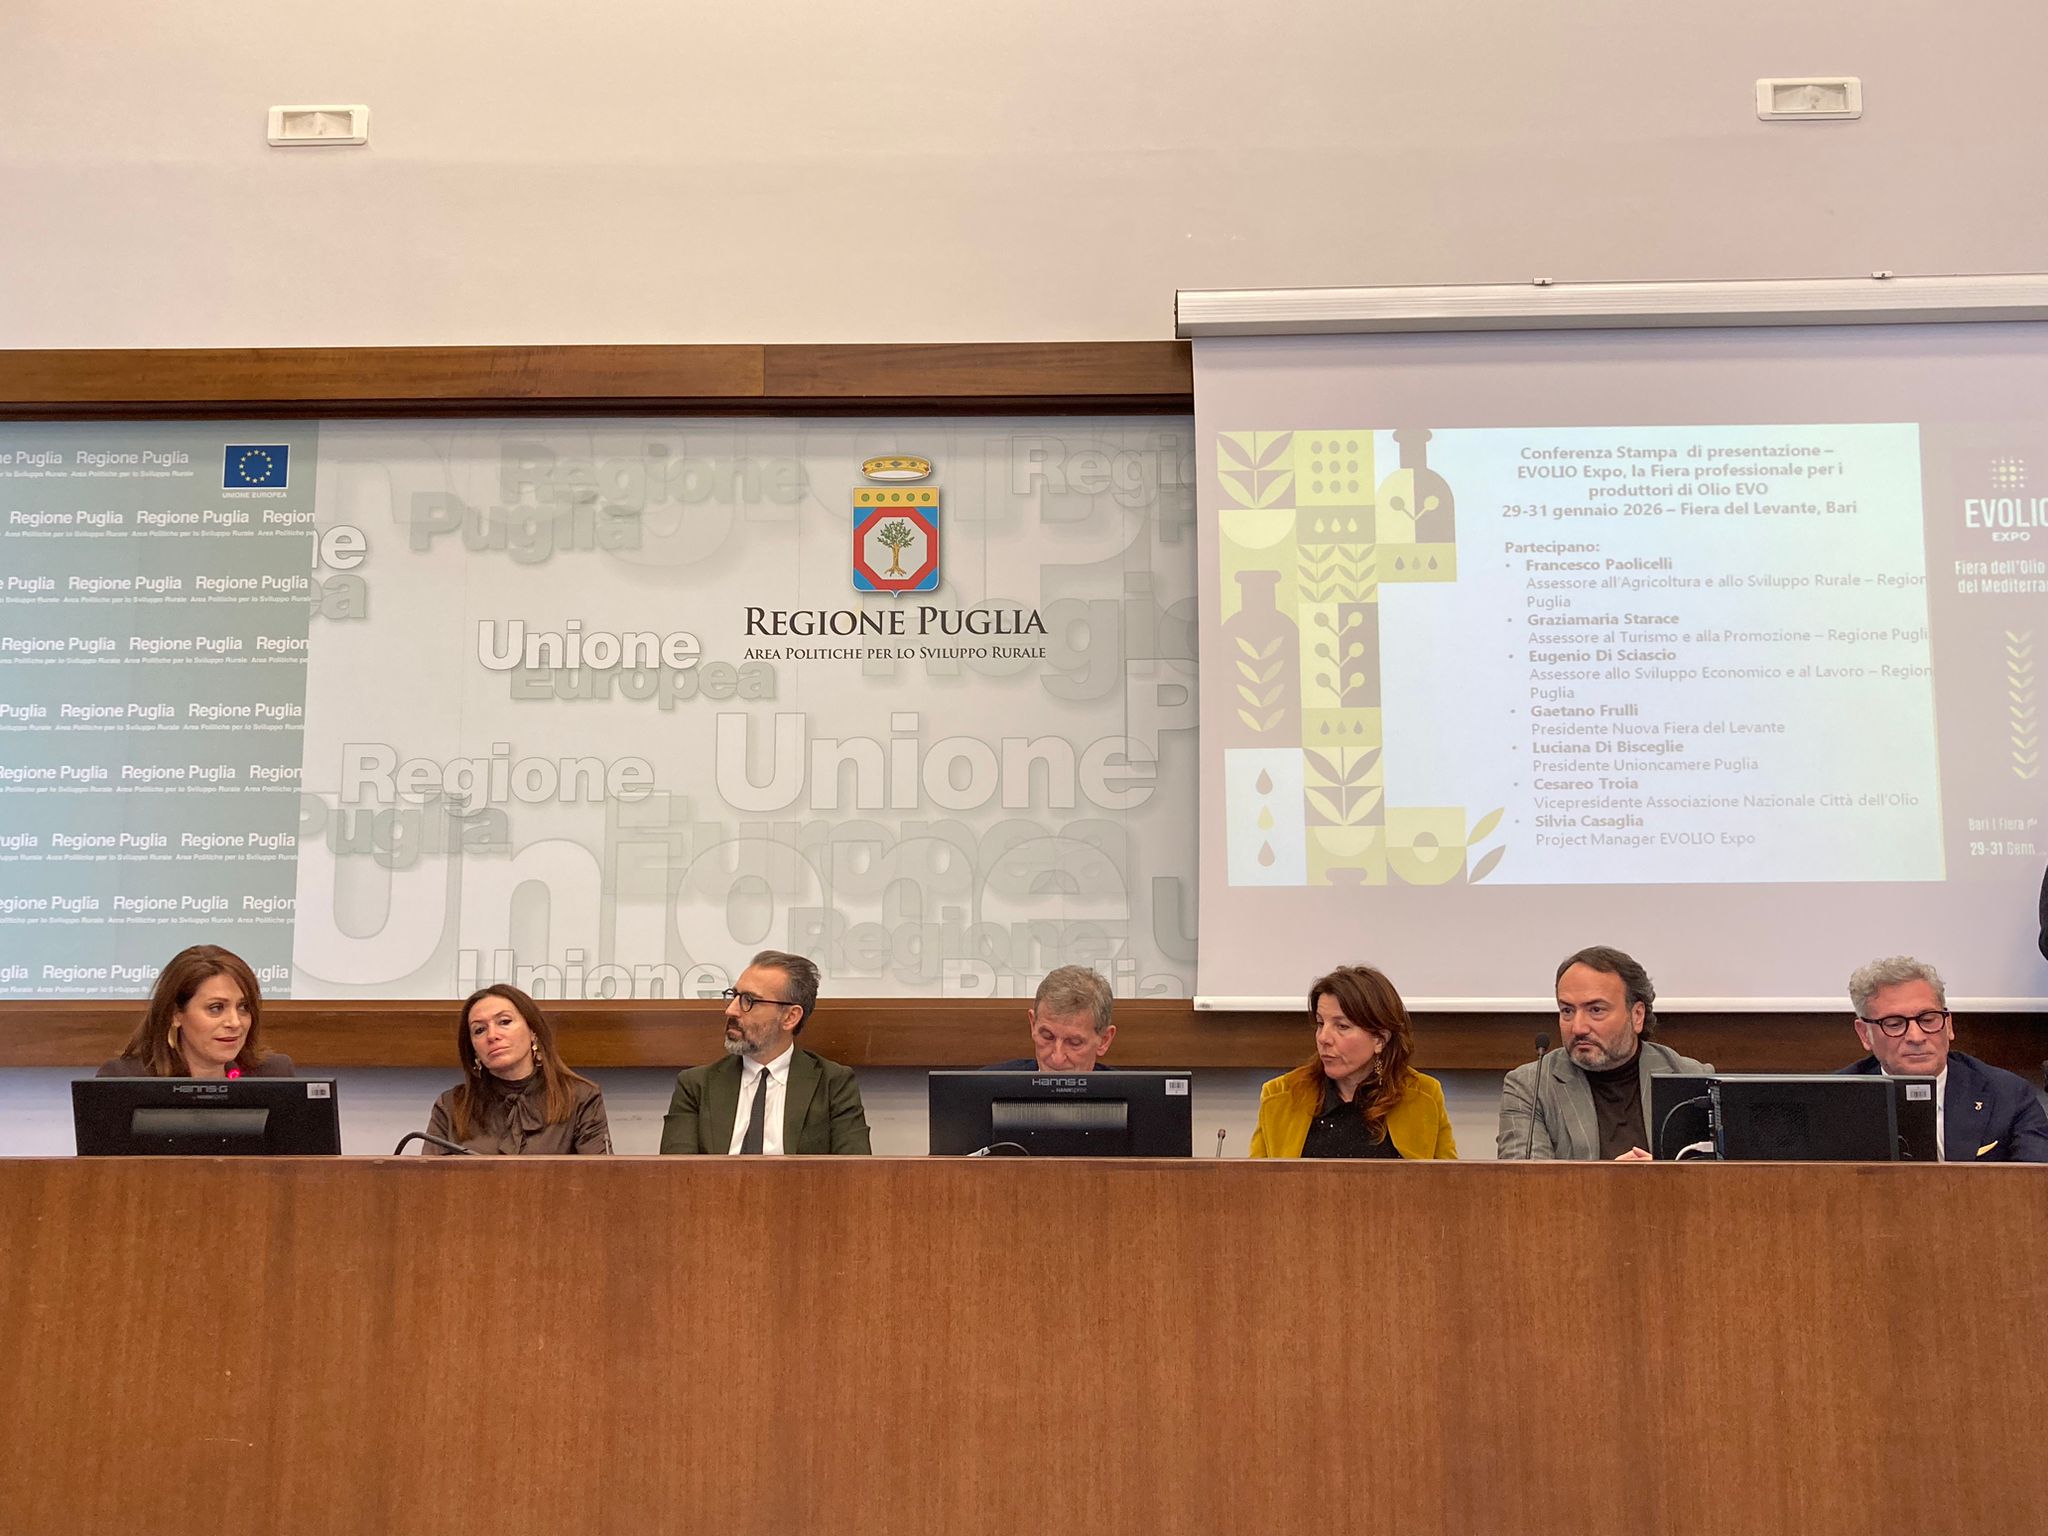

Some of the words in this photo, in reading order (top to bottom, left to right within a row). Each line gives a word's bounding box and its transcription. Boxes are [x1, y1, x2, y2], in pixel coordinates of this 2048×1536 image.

[16, 451, 62, 467] Puglia
[77, 451, 138, 467] Regione
[143, 451, 189, 467] Puglia
[1521, 447, 1612, 460] Conferenza
[1617, 446, 1677, 461] Stampa
[1687, 445, 1701, 458] di
[1707, 445, 1820, 460] presentazione
[1518, 465, 1578, 478] EVOLIO
[1583, 465, 1626, 481] Expo,
[1632, 464, 1645, 477] la
[1651, 464, 1690, 477] Fiera
[1695, 463, 1802, 480] professionale
[1807, 465, 1834, 478] per
[1589, 484, 1673, 500] produttori
[1678, 484, 1692, 496] di
[1697, 483, 1731, 496] Olio
[1736, 483, 1768, 495] EVO
[137, 510, 199, 527] Regione
[203, 510, 249, 526] Puglia
[1502, 504, 1547, 517] 29-31
[1553, 504, 1618, 520] gennaio
[1623, 503, 1663, 516] 2026
[1681, 502, 1719, 515] Fiera
[1724, 502, 1749, 514] del
[1754, 501, 1820, 516] Levante,
[1826, 501, 1857, 514] Bari
[10, 511, 73, 527] Regione
[76, 511, 123, 527] Puglia
[409, 490, 643, 564] Puglia
[1991, 532, 2031, 541] EXPO
[1505, 540, 1600, 556] Partecipano:
[1526, 559, 1600, 571] Francesco
[1605, 557, 1672, 570] Paolicelli
[1955, 561, 1987, 575] Fiera
[1991, 560, 2045, 575] dell'Olio
[8, 576, 55, 593] Puglia
[69, 576, 131, 593] Regione
[135, 576, 182, 593] Puglia
[196, 576, 257, 592] Regione
[262, 575, 308, 592] Puglia
[1526, 577, 1597, 589] Assessore
[1601, 575, 1701, 592] all'Agricoltura
[1705, 578, 1713, 587] e
[1718, 575, 1743, 587] allo
[1748, 575, 1809, 590] Sviluppo
[1815, 573, 1860, 586] Rurale
[1958, 579, 1978, 593] del
[1527, 596, 1571, 610] Puglia
[744, 606, 905, 636] REGIONE
[917, 605, 1048, 635] PUGLIA
[1528, 613, 1619, 626] Graziamaria
[1624, 613, 1680, 625] Starace
[1528, 632, 1599, 644] Assessore
[1603, 631, 1615, 643] al
[1620, 631, 1677, 643] Turismo
[1682, 634, 1691, 642] e
[1696, 630, 1720, 642] alla
[1724, 628, 1811, 642] Promozione
[1828, 628, 1888, 644] Regione
[2, 637, 65, 654] Regione
[69, 637, 116, 654] Puglia
[129, 637, 192, 654] Regione
[196, 636, 243, 653] Puglia
[478, 619, 701, 671] Unione
[1529, 650, 1591, 665] Eugenio
[1596, 649, 1612, 661] Di
[1617, 649, 1676, 661] Sciascio
[1529, 668, 1600, 680] Assessore
[1605, 667, 1630, 679] allo
[1635, 667, 1697, 682] Sviluppo
[1702, 665, 1781, 679] Economico
[1786, 669, 1795, 678] e
[1798, 665, 1810, 678] al
[1816, 665, 1864, 678] Lavoro
[510, 655, 776, 710] Europea
[1530, 687, 1575, 701] Puglia
[61, 704, 124, 720] Regione
[128, 704, 174, 720] Puglia
[189, 703, 251, 720] Regione
[255, 703, 302, 720] Puglia
[1531, 705, 1595, 717] Gaetano
[1600, 704, 1638, 717] Frulli
[1532, 722, 1608, 735] Presidente
[1612, 723, 1659, 734] Nuova
[1664, 722, 1699, 734] Fiera
[1703, 722, 1725, 734] del
[1730, 722, 1785, 734] Levante
[1532, 741, 1591, 753] Luciana
[1596, 741, 1612, 753] Di
[1617, 740, 1684, 755] Bisceglie
[715, 711, 1158, 812] Unione
[1533, 759, 1609, 772] Presidente
[1614, 758, 1711, 771] Unioncamere
[1714, 757, 1759, 773] Puglia
[60, 765, 107, 782] Puglia
[122, 765, 185, 782] Regione
[189, 765, 235, 782] Puglia
[342, 742, 655, 818] Regione
[1534, 778, 1594, 790] Cesareo
[1599, 777, 1639, 789] Troia
[1534, 796, 1642, 811] Vicepresidente
[1646, 794, 1738, 808] Associazione
[1744, 793, 1815, 807] Nazionale
[1820, 793, 1853, 806] Città
[1858, 792, 1919, 806] dell'Olio
[1535, 815, 1576, 827] Silvia
[1581, 814, 1644, 829] Casaglia
[1968, 818, 1989, 831] Bari
[1999, 818, 2024, 831] Fiera
[52, 833, 115, 850] Regione
[120, 833, 167, 850] Puglia
[181, 833, 244, 850] Regione
[248, 833, 295, 850] Puglia
[1536, 833, 1586, 848] Project
[1591, 833, 1655, 848] Manager
[1660, 832, 1715, 845] EVOLIO
[1721, 832, 1755, 846] Expo
[1970, 841, 2003, 856] 29-31
